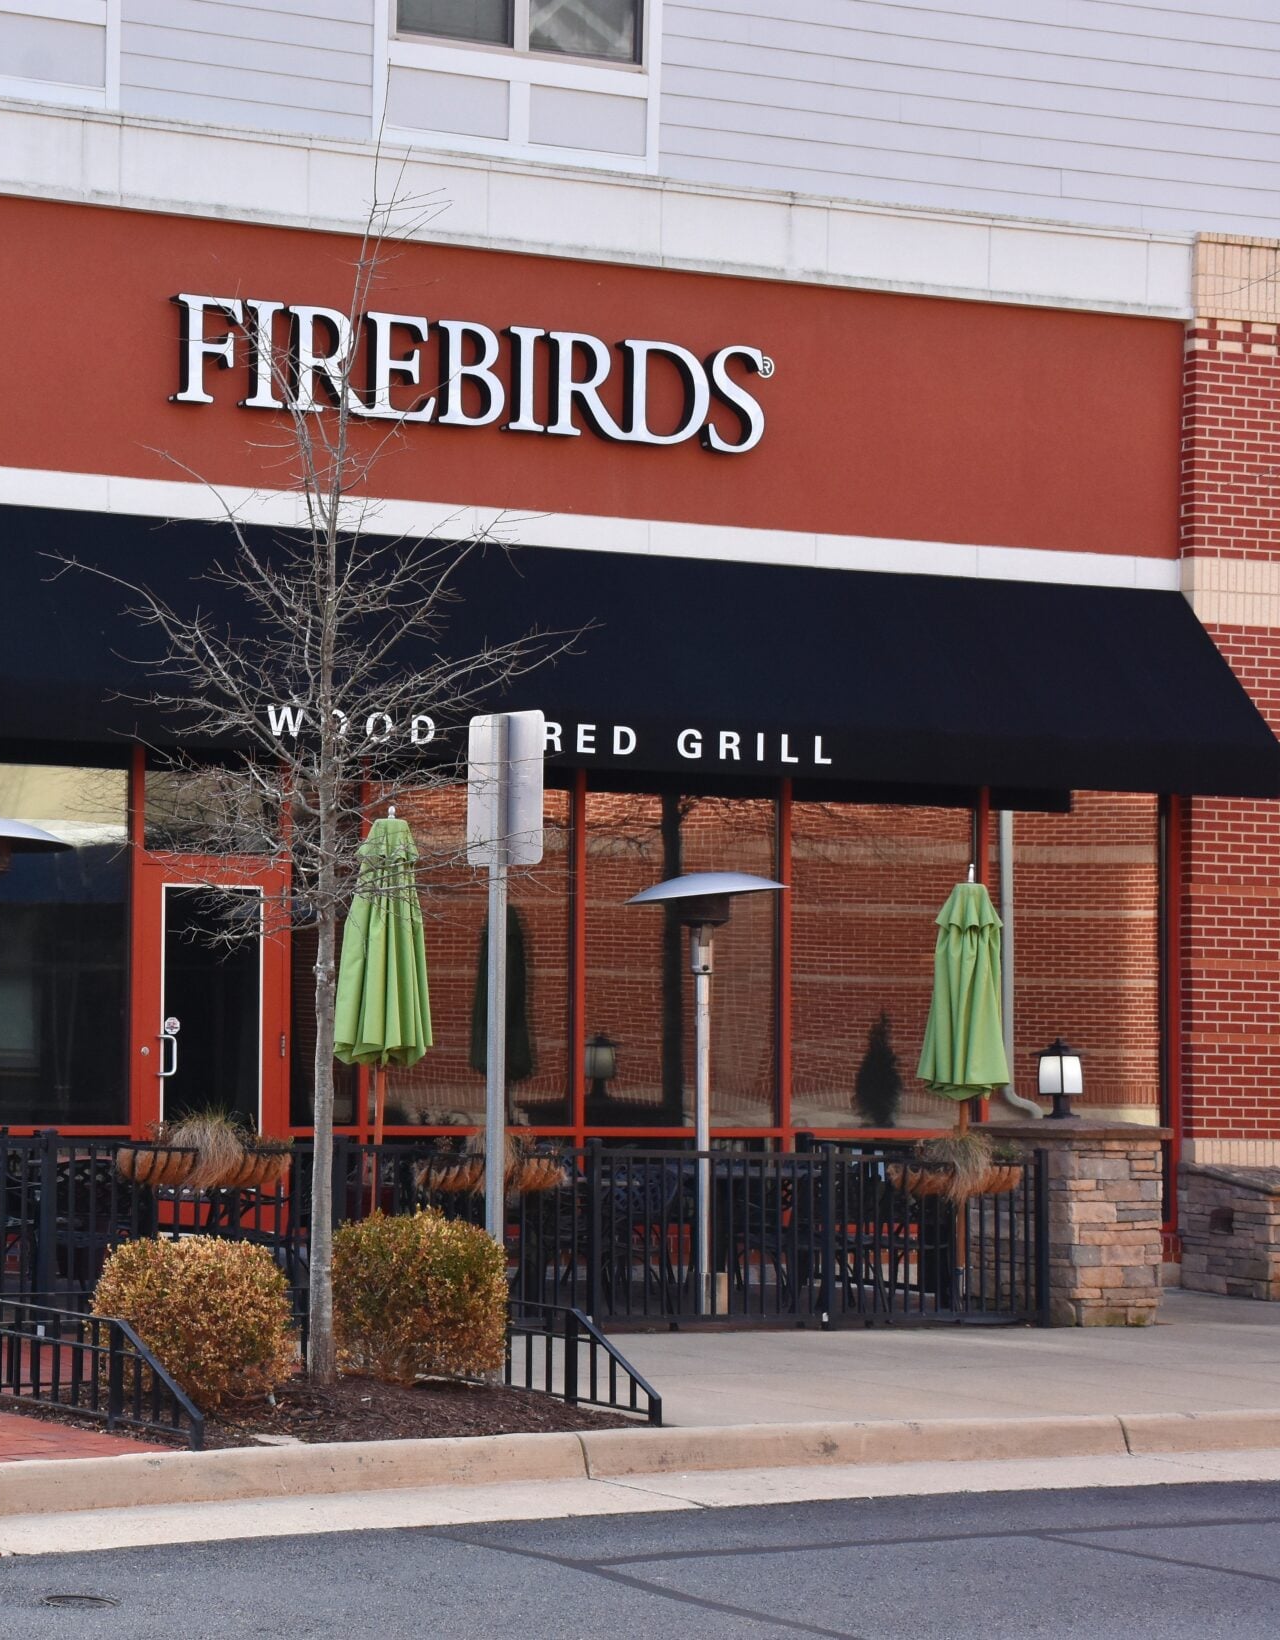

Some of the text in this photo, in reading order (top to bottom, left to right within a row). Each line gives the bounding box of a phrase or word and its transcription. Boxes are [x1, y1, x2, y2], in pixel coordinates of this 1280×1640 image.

[173, 292, 767, 454] FIREBIRDS
[543, 721, 637, 755] RED
[677, 728, 832, 764] GRILL
